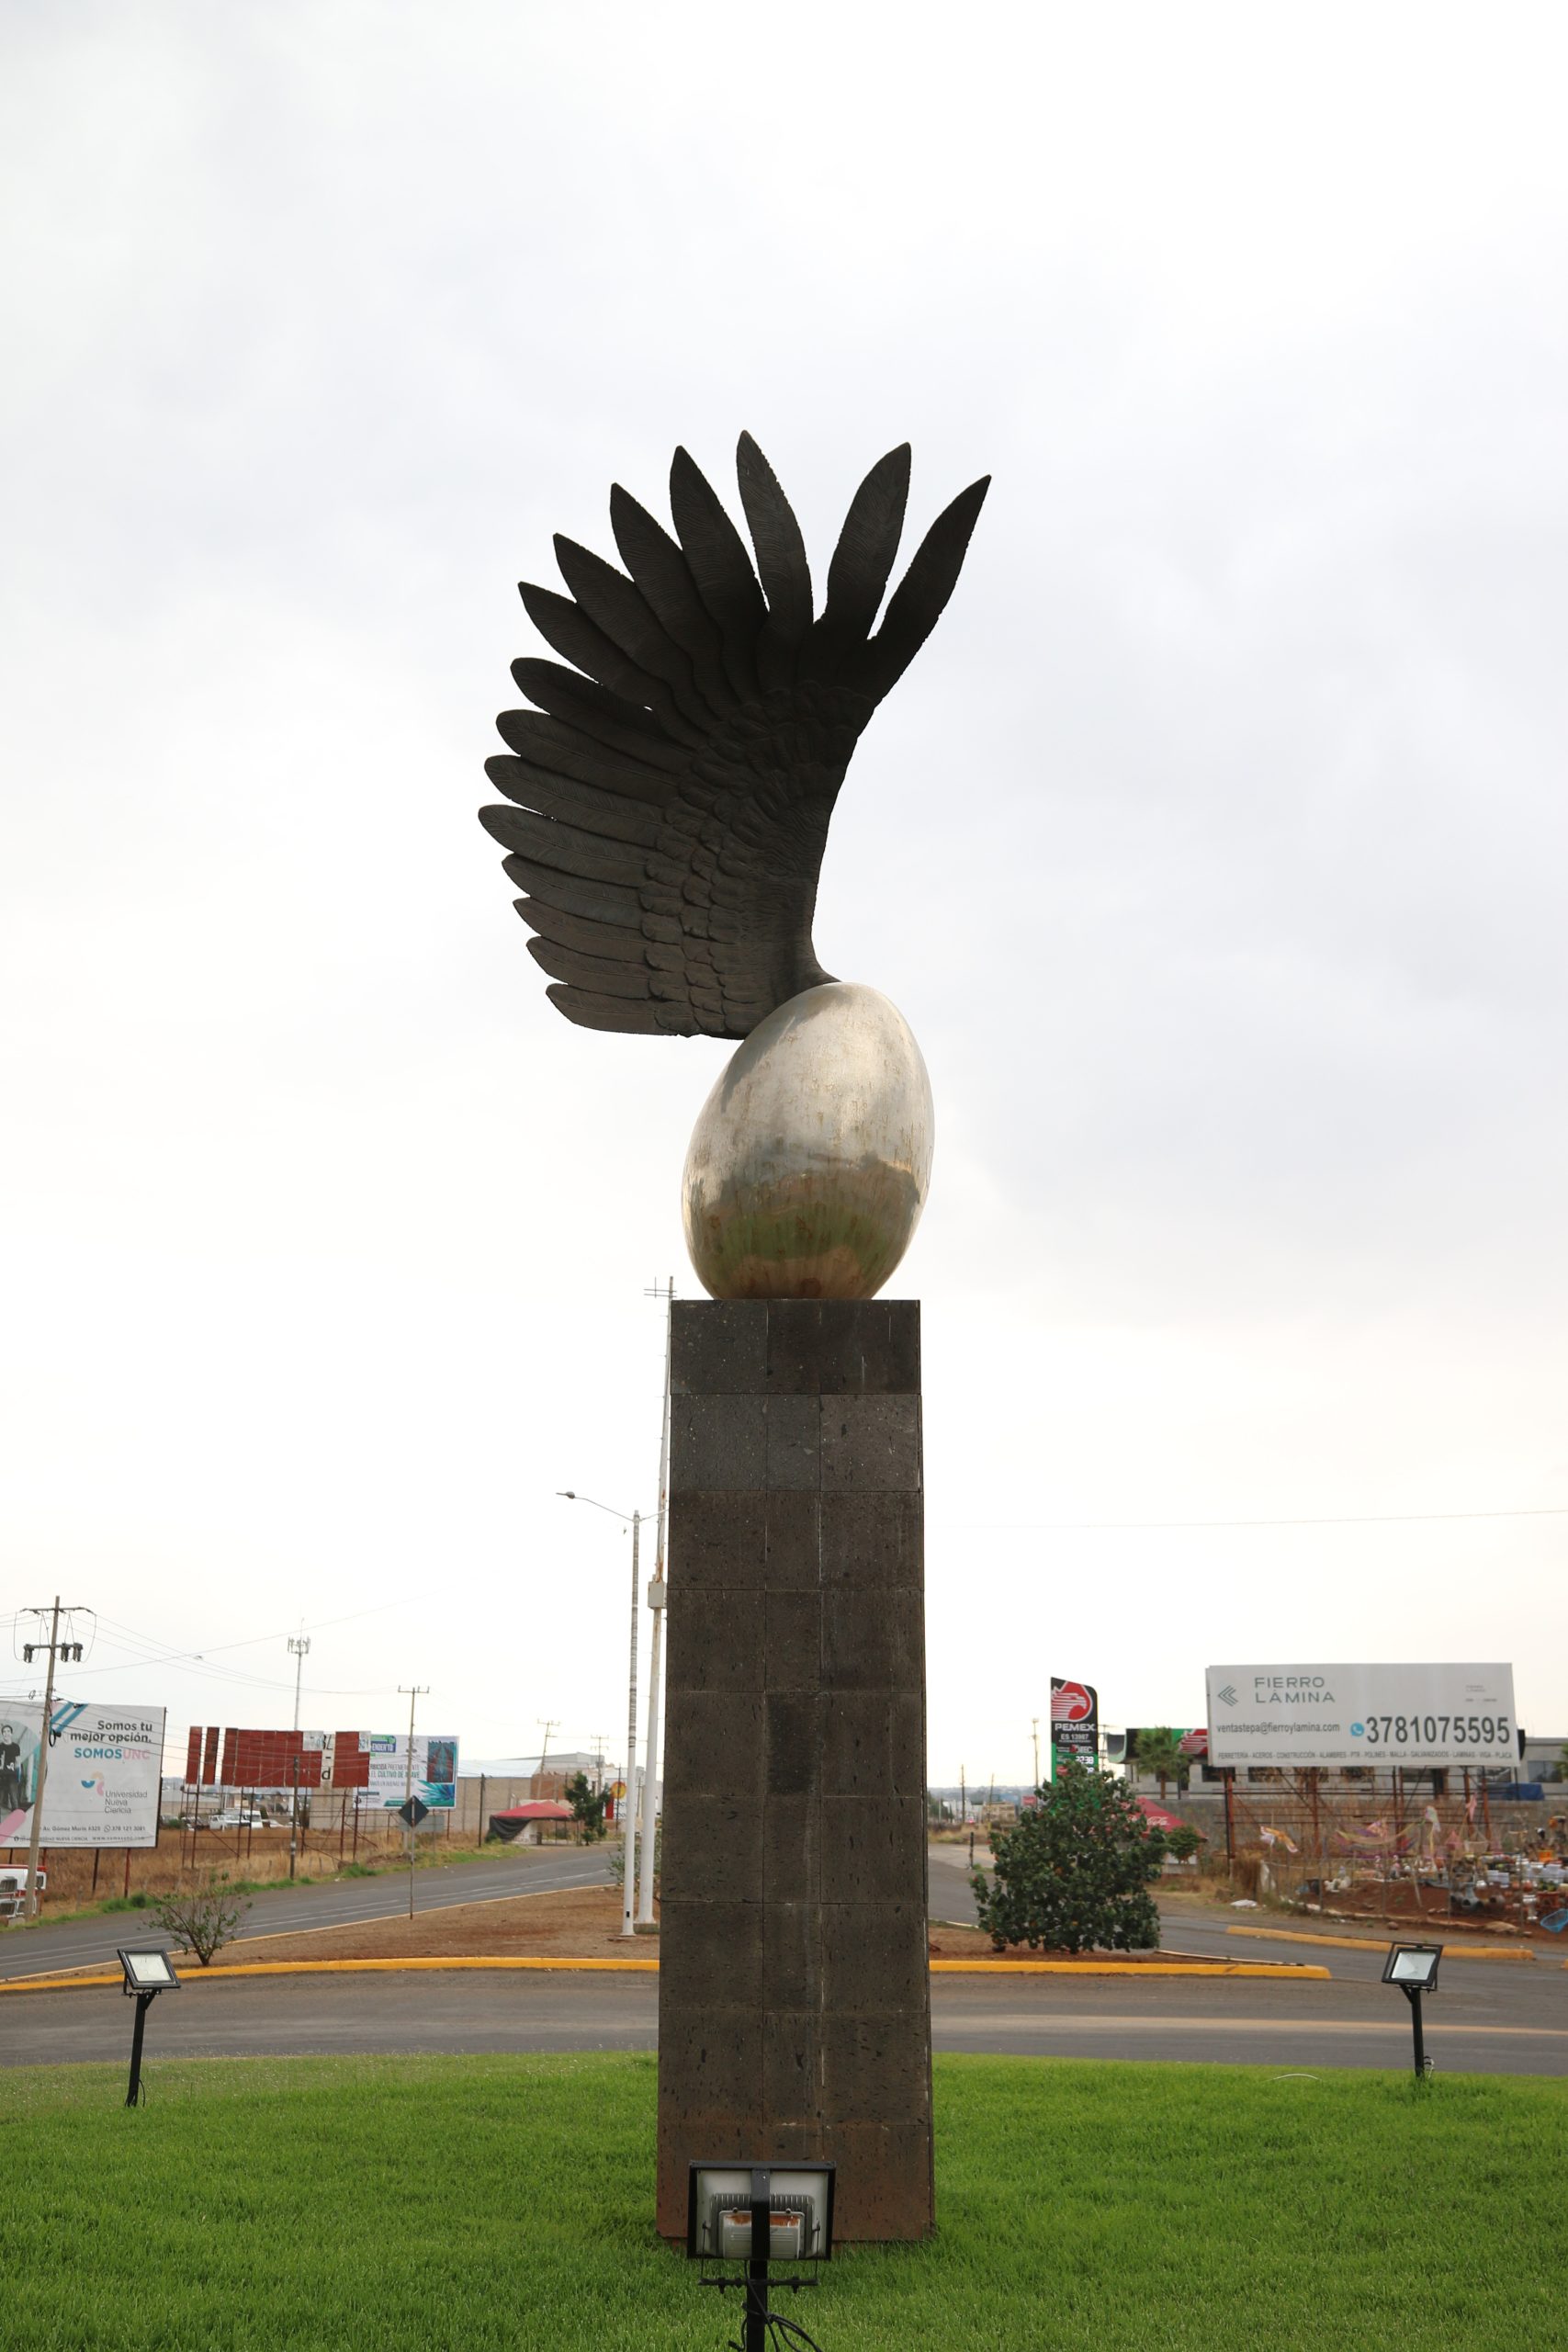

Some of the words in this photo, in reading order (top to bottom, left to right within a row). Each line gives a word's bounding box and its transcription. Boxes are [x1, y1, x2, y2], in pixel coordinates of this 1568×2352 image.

[1255, 1677, 1325, 1688] FIERRO
[1256, 1690, 1336, 1703] LÁMINA
[97, 1720, 137, 1731] Somos
[141, 1722, 152, 1732] tu
[1217, 1722, 1339, 1735] ventastepa@fierroylamina.com
[1366, 1716, 1510, 1744] 3781075595
[70, 1732, 105, 1743] mejor
[108, 1732, 152, 1744] opción.
[1495, 1751, 1513, 1759] PLACA
